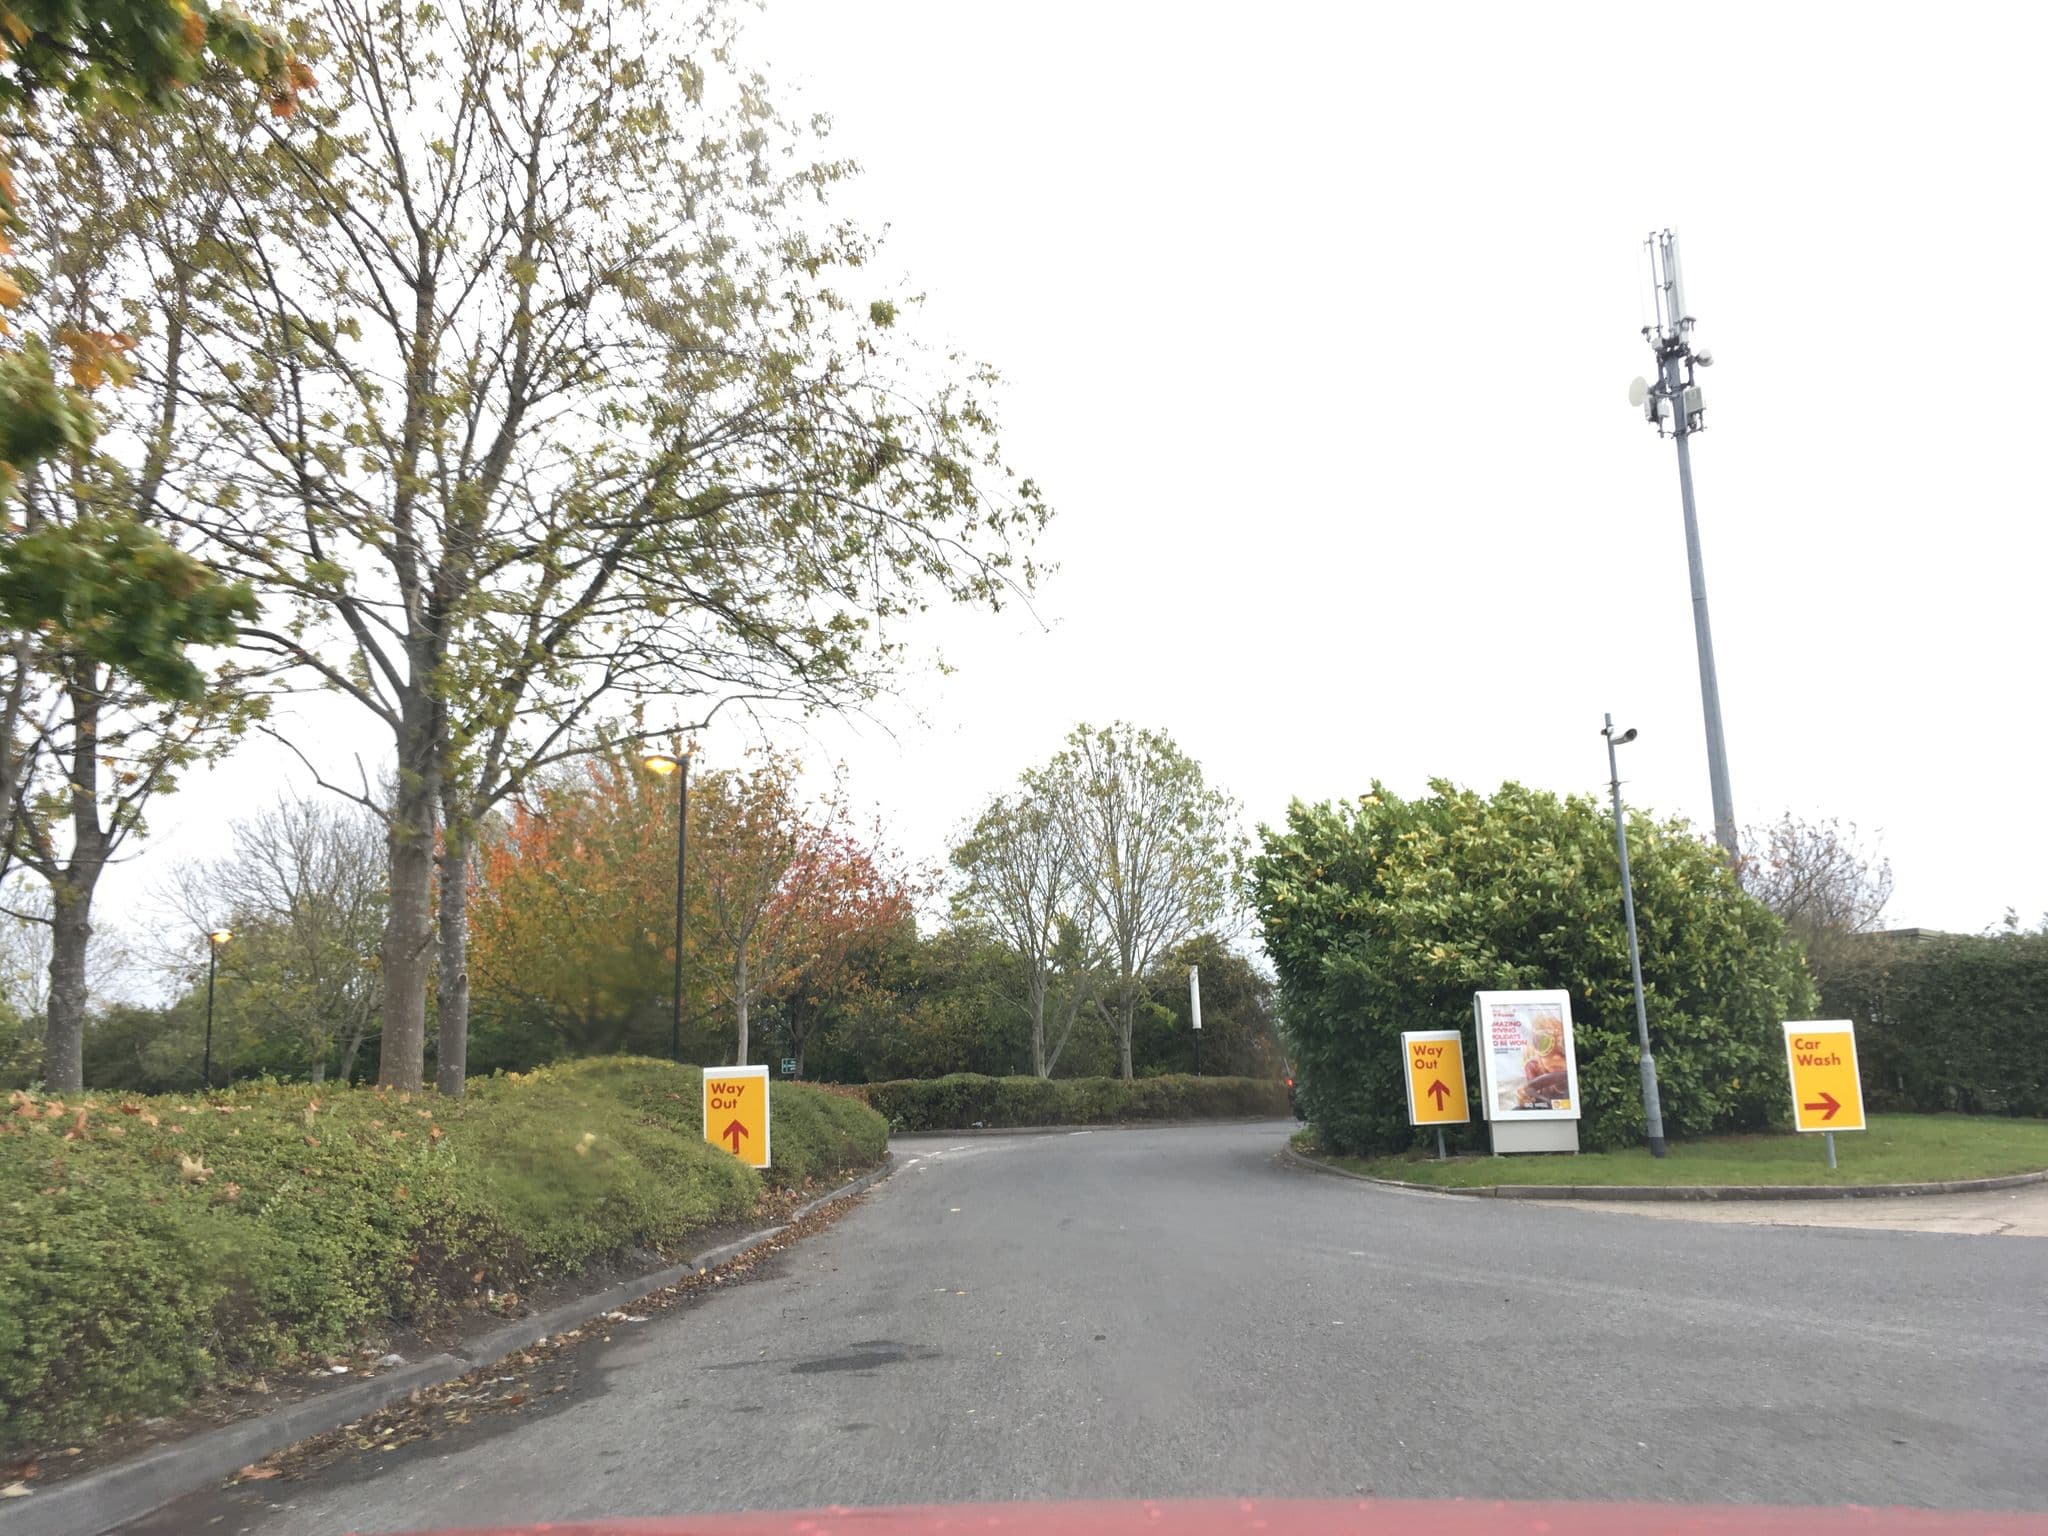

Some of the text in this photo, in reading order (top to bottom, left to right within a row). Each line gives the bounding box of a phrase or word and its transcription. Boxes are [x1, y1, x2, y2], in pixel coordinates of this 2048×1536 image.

[1794, 1038, 1820, 1050] Car
[1413, 1045, 1443, 1058] Way
[1415, 1059, 1438, 1070] Out
[1797, 1053, 1840, 1066] Wash
[711, 1083, 744, 1097] Way
[711, 1098, 738, 1110] Out
